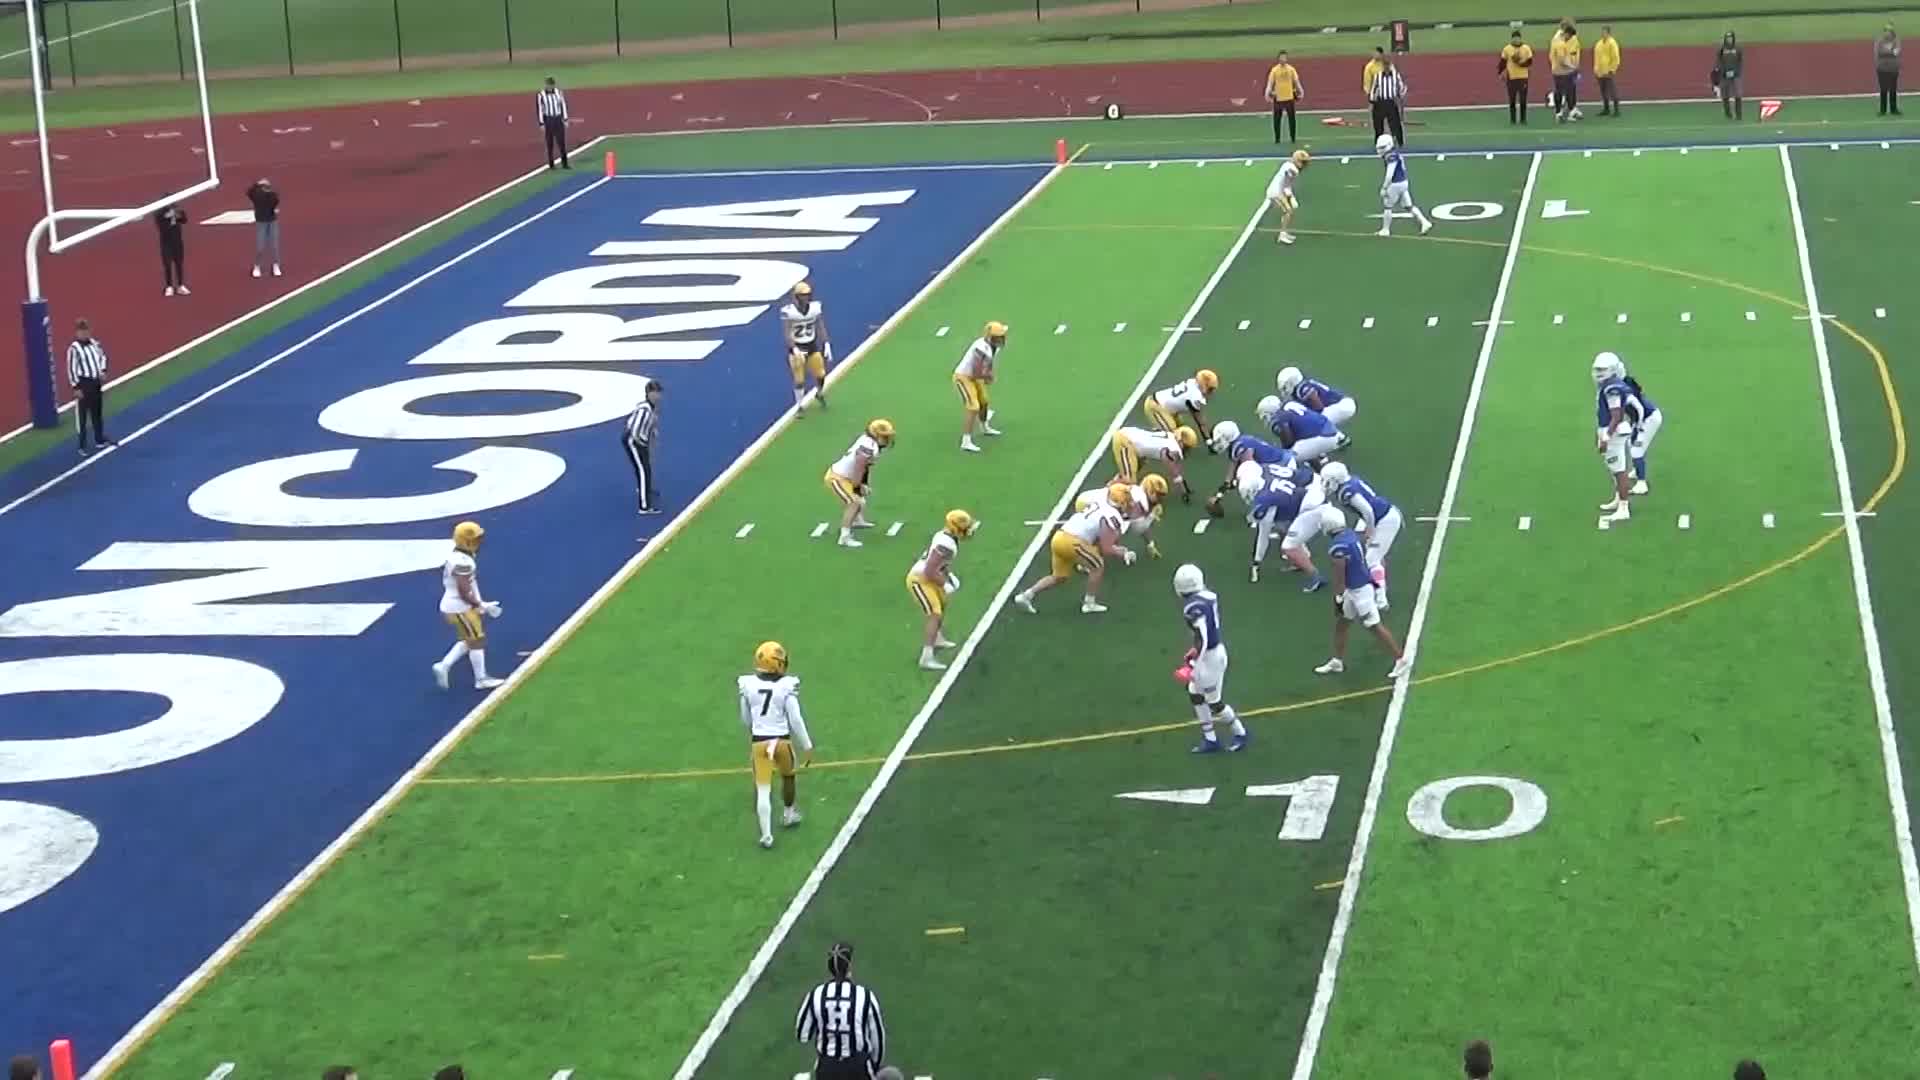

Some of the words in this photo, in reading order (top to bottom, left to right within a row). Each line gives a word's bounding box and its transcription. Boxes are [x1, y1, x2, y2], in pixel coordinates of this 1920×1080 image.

[794, 322, 814, 338] 25
[0, 188, 915, 913] ONCORDIA
[757, 688, 773, 717] 7
[1245, 774, 1548, 841] 10
[824, 1000, 851, 1032] H
